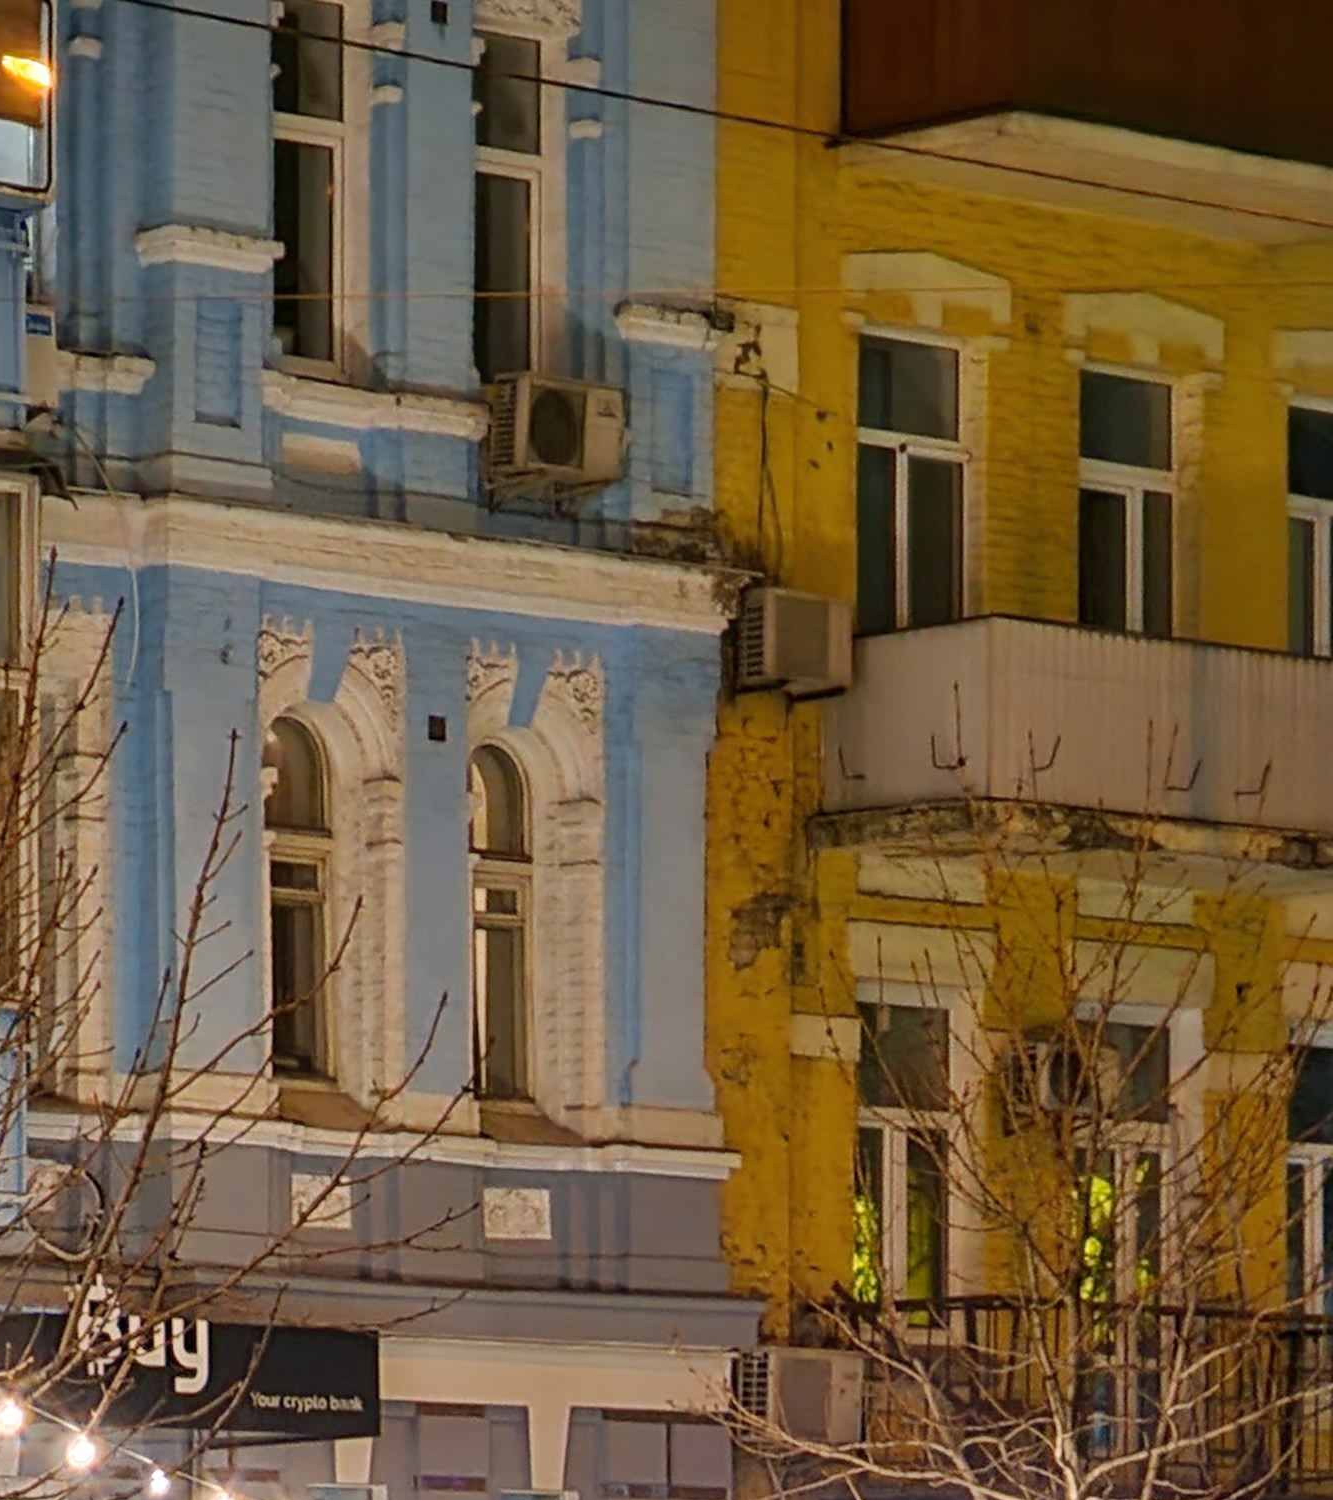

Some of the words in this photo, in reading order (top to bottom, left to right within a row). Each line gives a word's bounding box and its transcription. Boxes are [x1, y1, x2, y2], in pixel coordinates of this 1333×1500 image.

[250, 1392, 281, 1408] Your
[283, 1395, 327, 1413] crypto
[329, 1394, 364, 1412] bank
